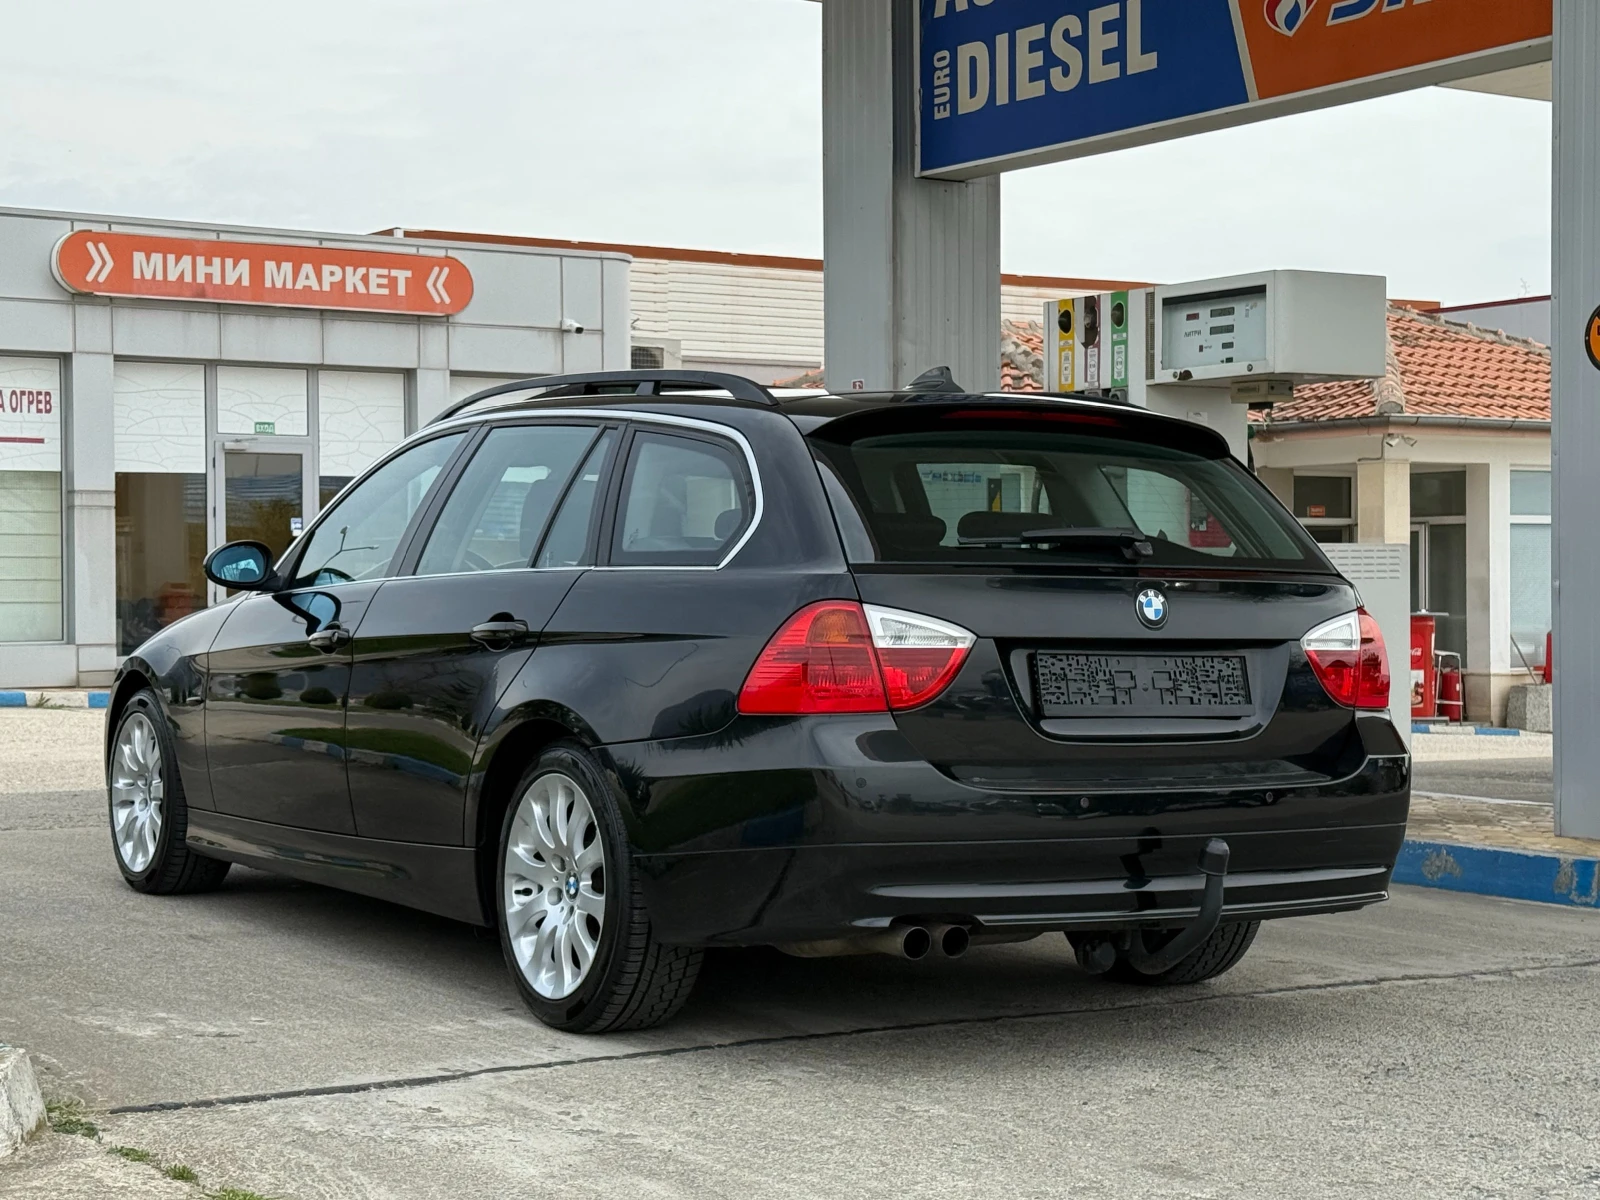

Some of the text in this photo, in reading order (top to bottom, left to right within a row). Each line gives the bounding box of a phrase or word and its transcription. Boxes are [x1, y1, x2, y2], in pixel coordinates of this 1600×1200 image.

[957, 0, 1158, 115] DIESEL
[933, 50, 950, 120] EURO
[132, 251, 412, 296] МИНИ МАРКЕТ
[10, 390, 52, 414] ОГРЕВ
[255, 424, 274, 433] ВХОД
[1139, 590, 1165, 603] BMW
